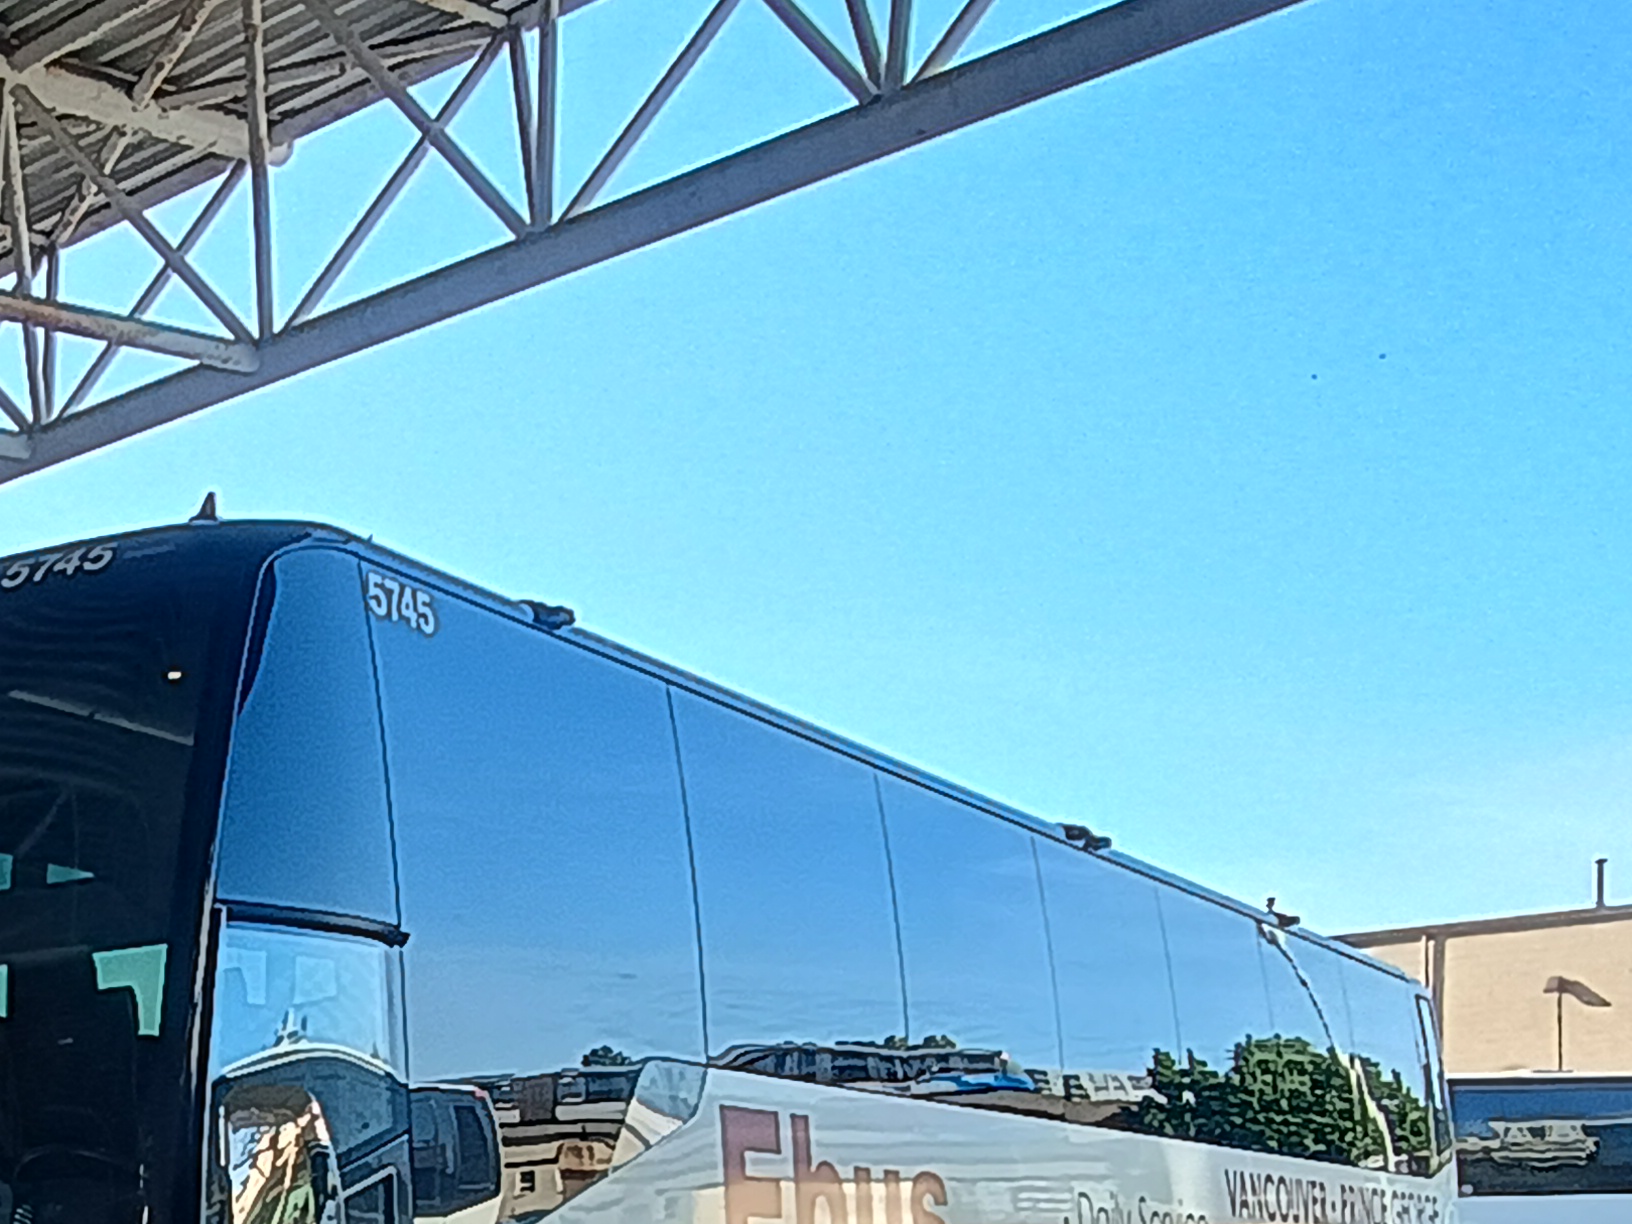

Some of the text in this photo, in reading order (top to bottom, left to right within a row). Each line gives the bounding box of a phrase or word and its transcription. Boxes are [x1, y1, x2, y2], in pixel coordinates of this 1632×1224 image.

[1, 542, 118, 588] 5745
[367, 571, 435, 634] 5745
[1224, 1168, 1328, 1224] VANCOUVER
